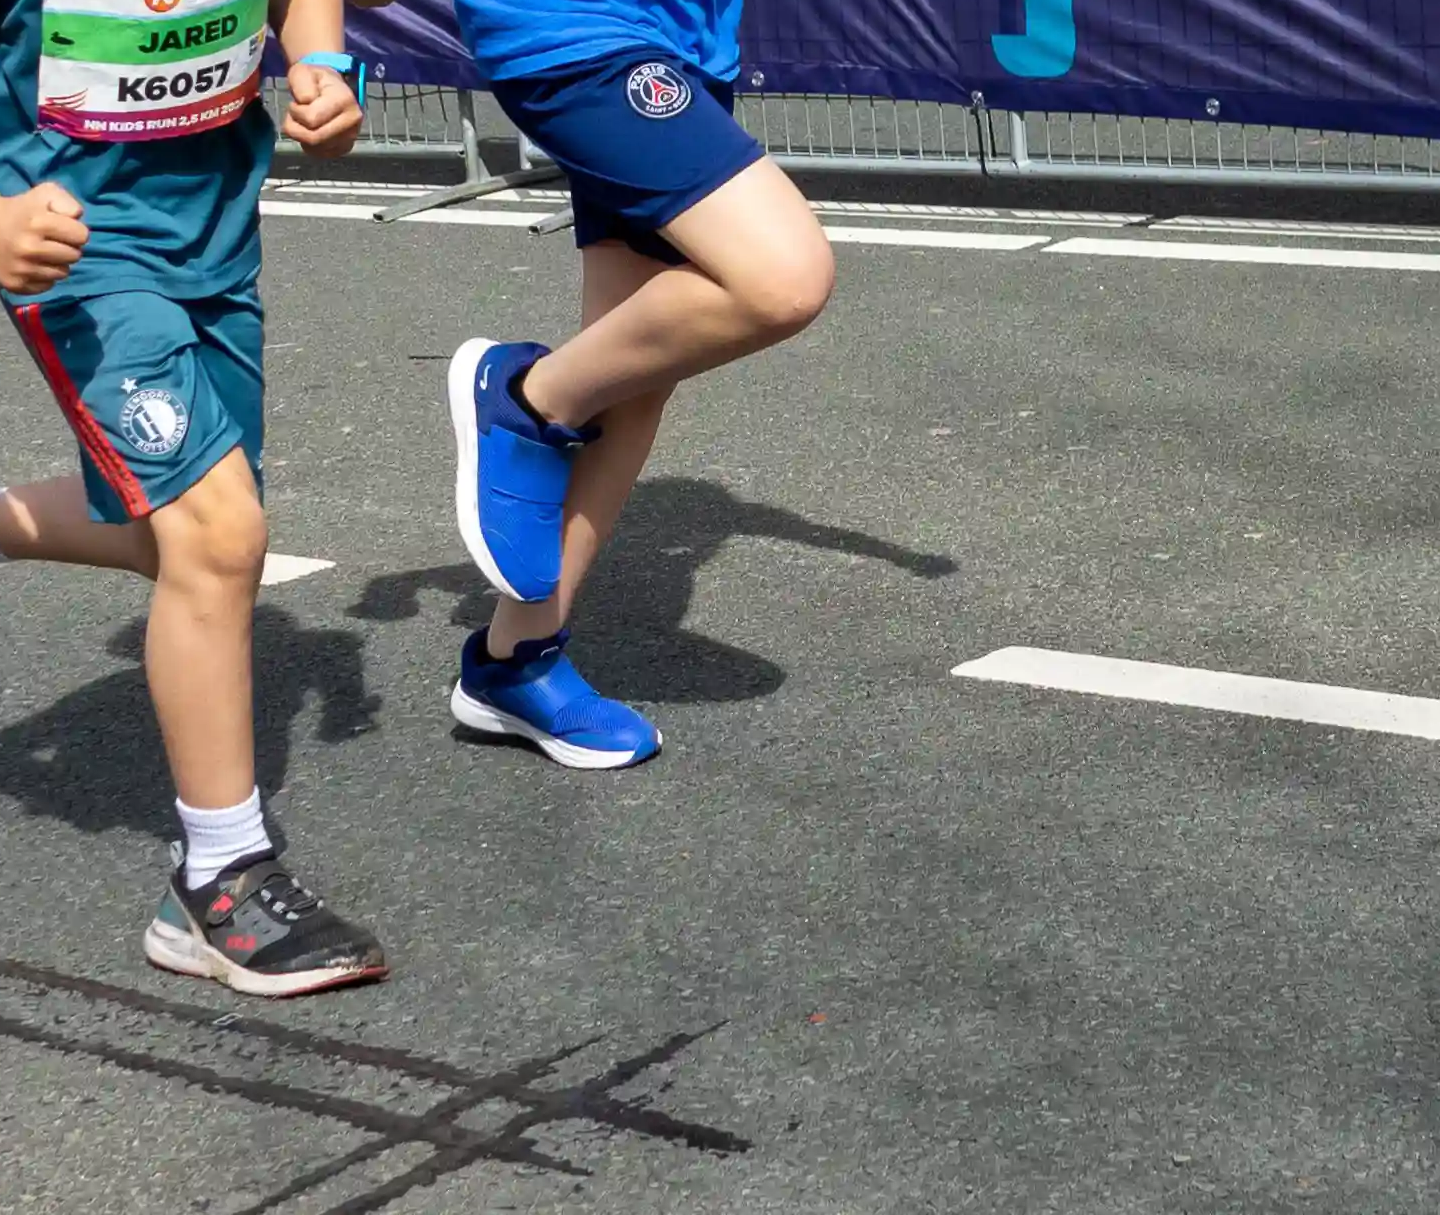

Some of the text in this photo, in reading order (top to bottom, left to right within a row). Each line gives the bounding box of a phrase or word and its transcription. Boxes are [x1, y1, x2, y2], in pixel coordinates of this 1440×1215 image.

[138, 14, 239, 54] JARED
[117, 61, 231, 103] K6057
[630, 65, 666, 90] PARIS
[84, 119, 107, 131] NN
[110, 120, 145, 132] KIDS
[146, 117, 177, 130] RUN
[178, 113, 199, 127] 2,5
[200, 107, 220, 123] KM
